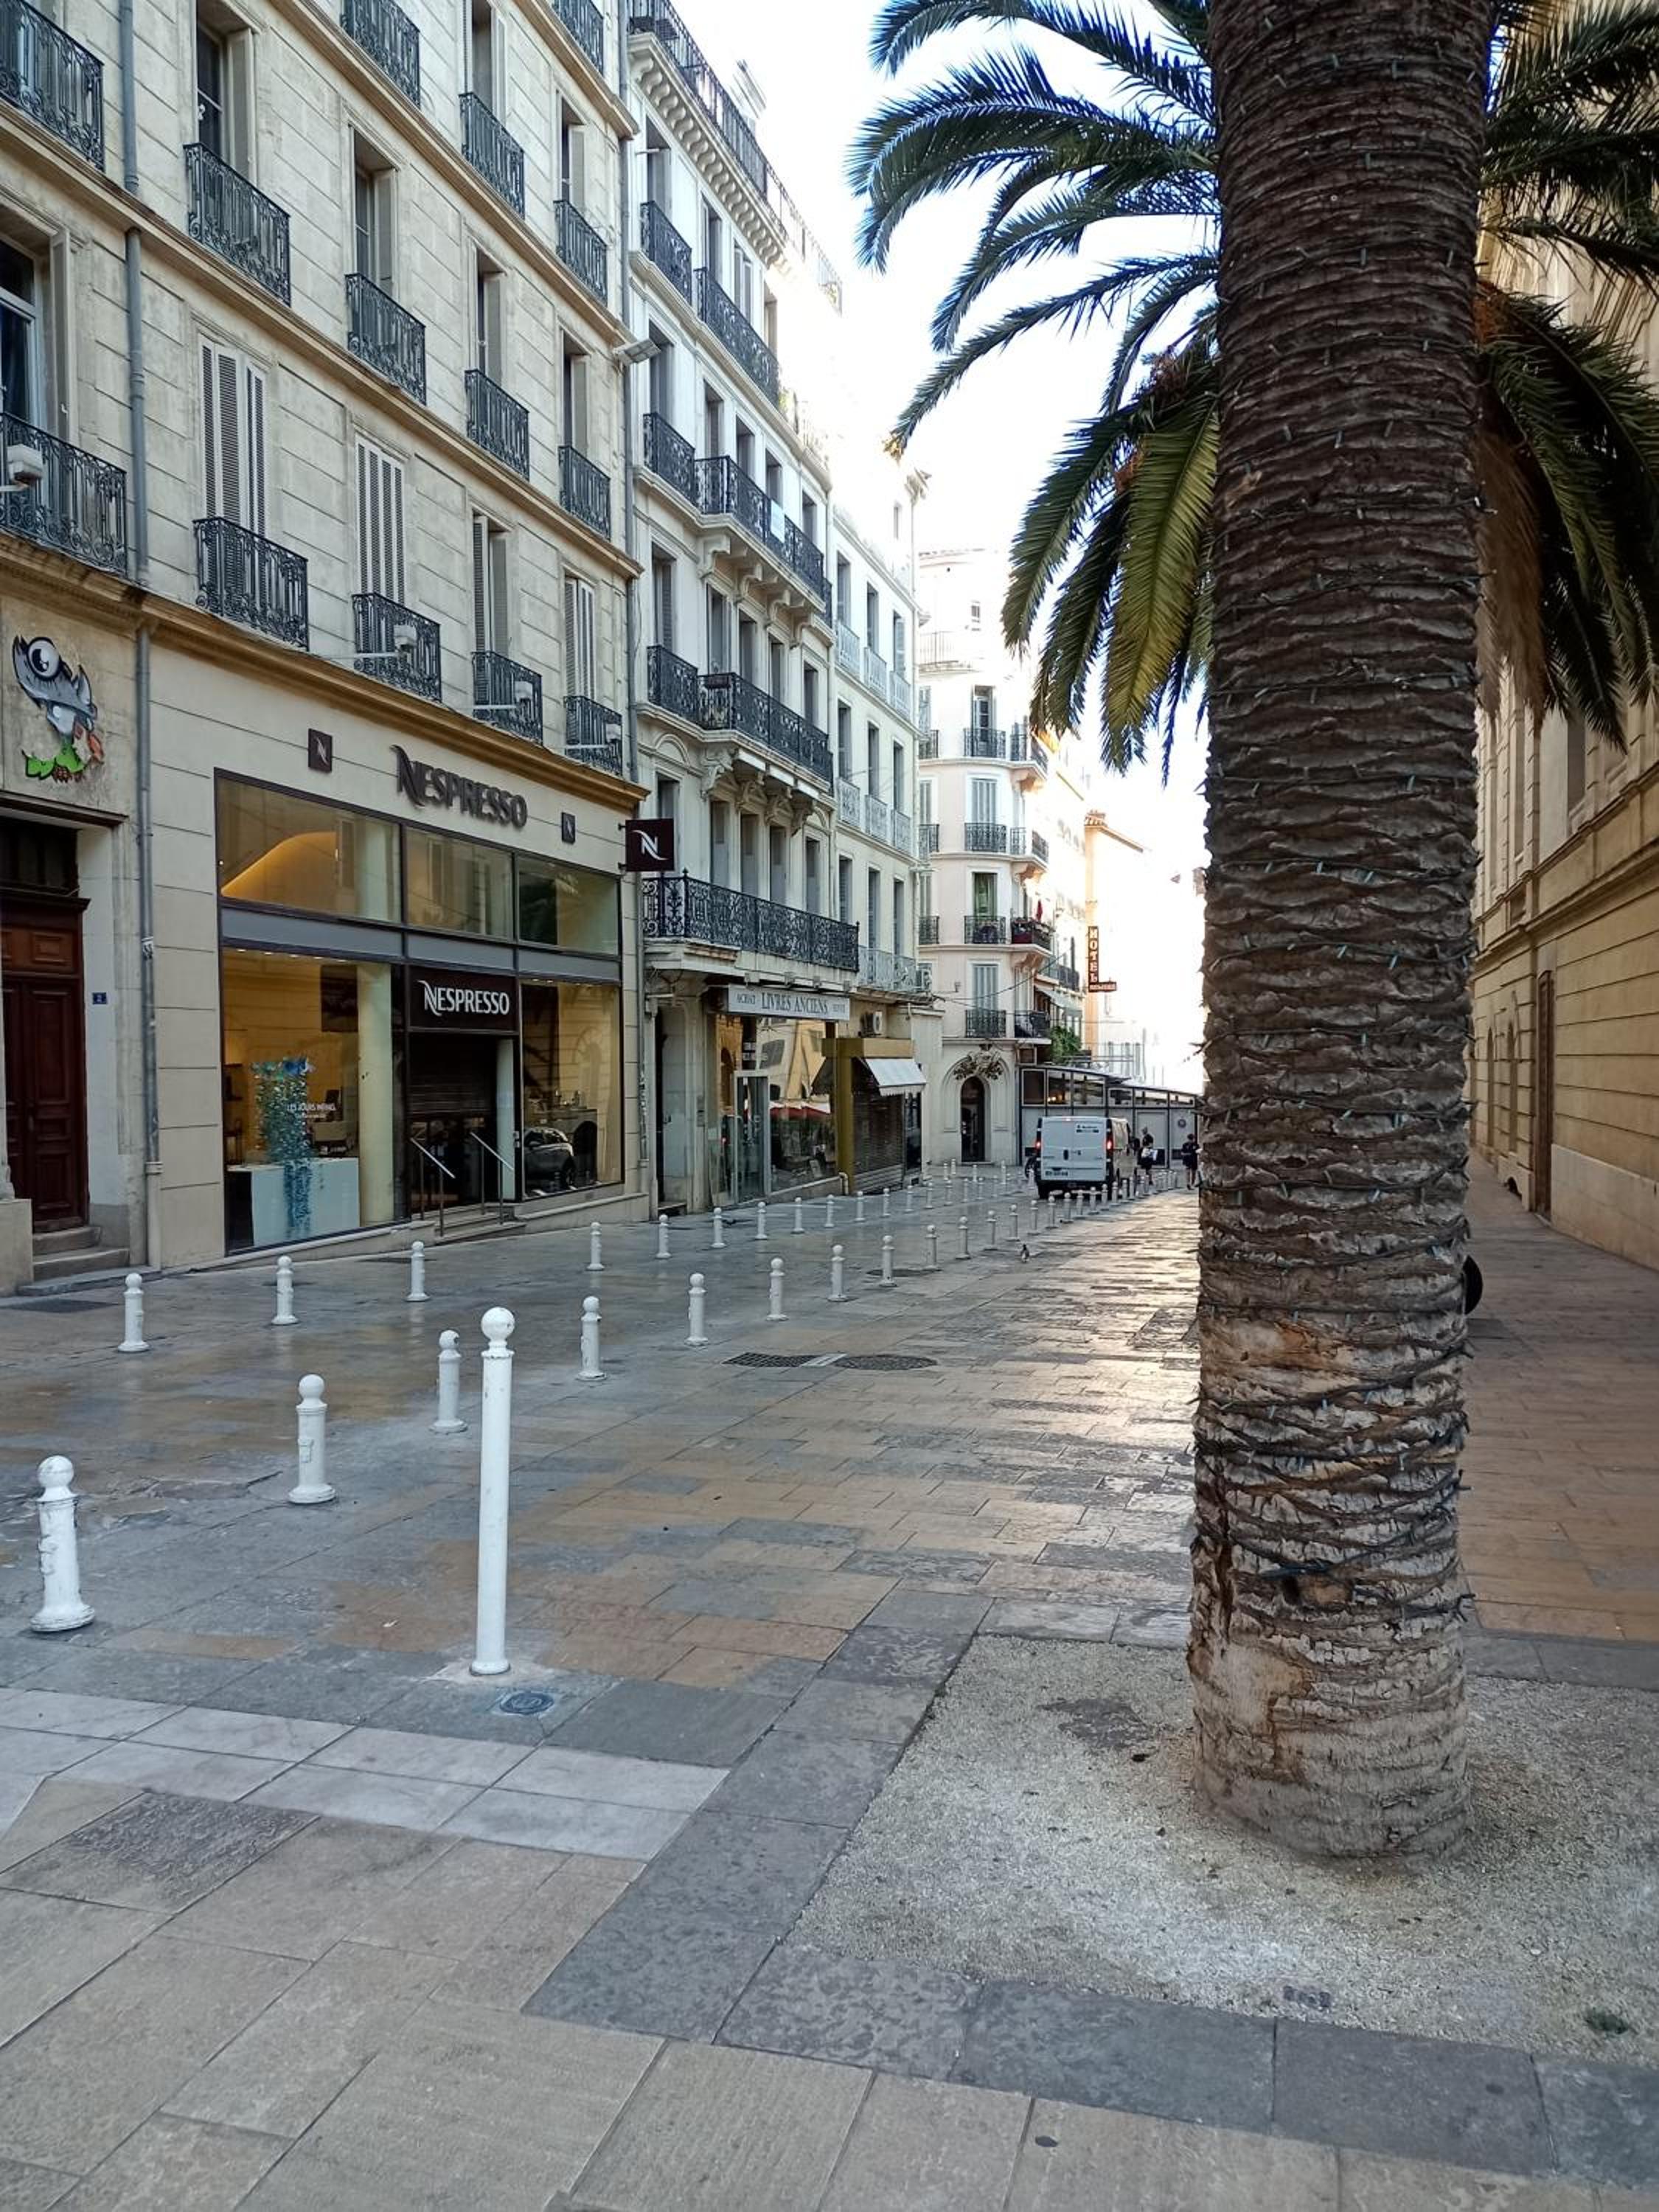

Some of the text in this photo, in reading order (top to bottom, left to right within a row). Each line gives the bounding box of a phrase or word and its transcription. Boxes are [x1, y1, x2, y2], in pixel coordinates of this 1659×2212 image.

[391, 744, 527, 828] NESPRESSO
[633, 830, 668, 860] N
[1089, 928, 1098, 982] HOTEL
[417, 980, 510, 1015] NESPRESSO
[762, 992, 791, 1012] LIVRES
[794, 996, 828, 1015] ANCIENS
